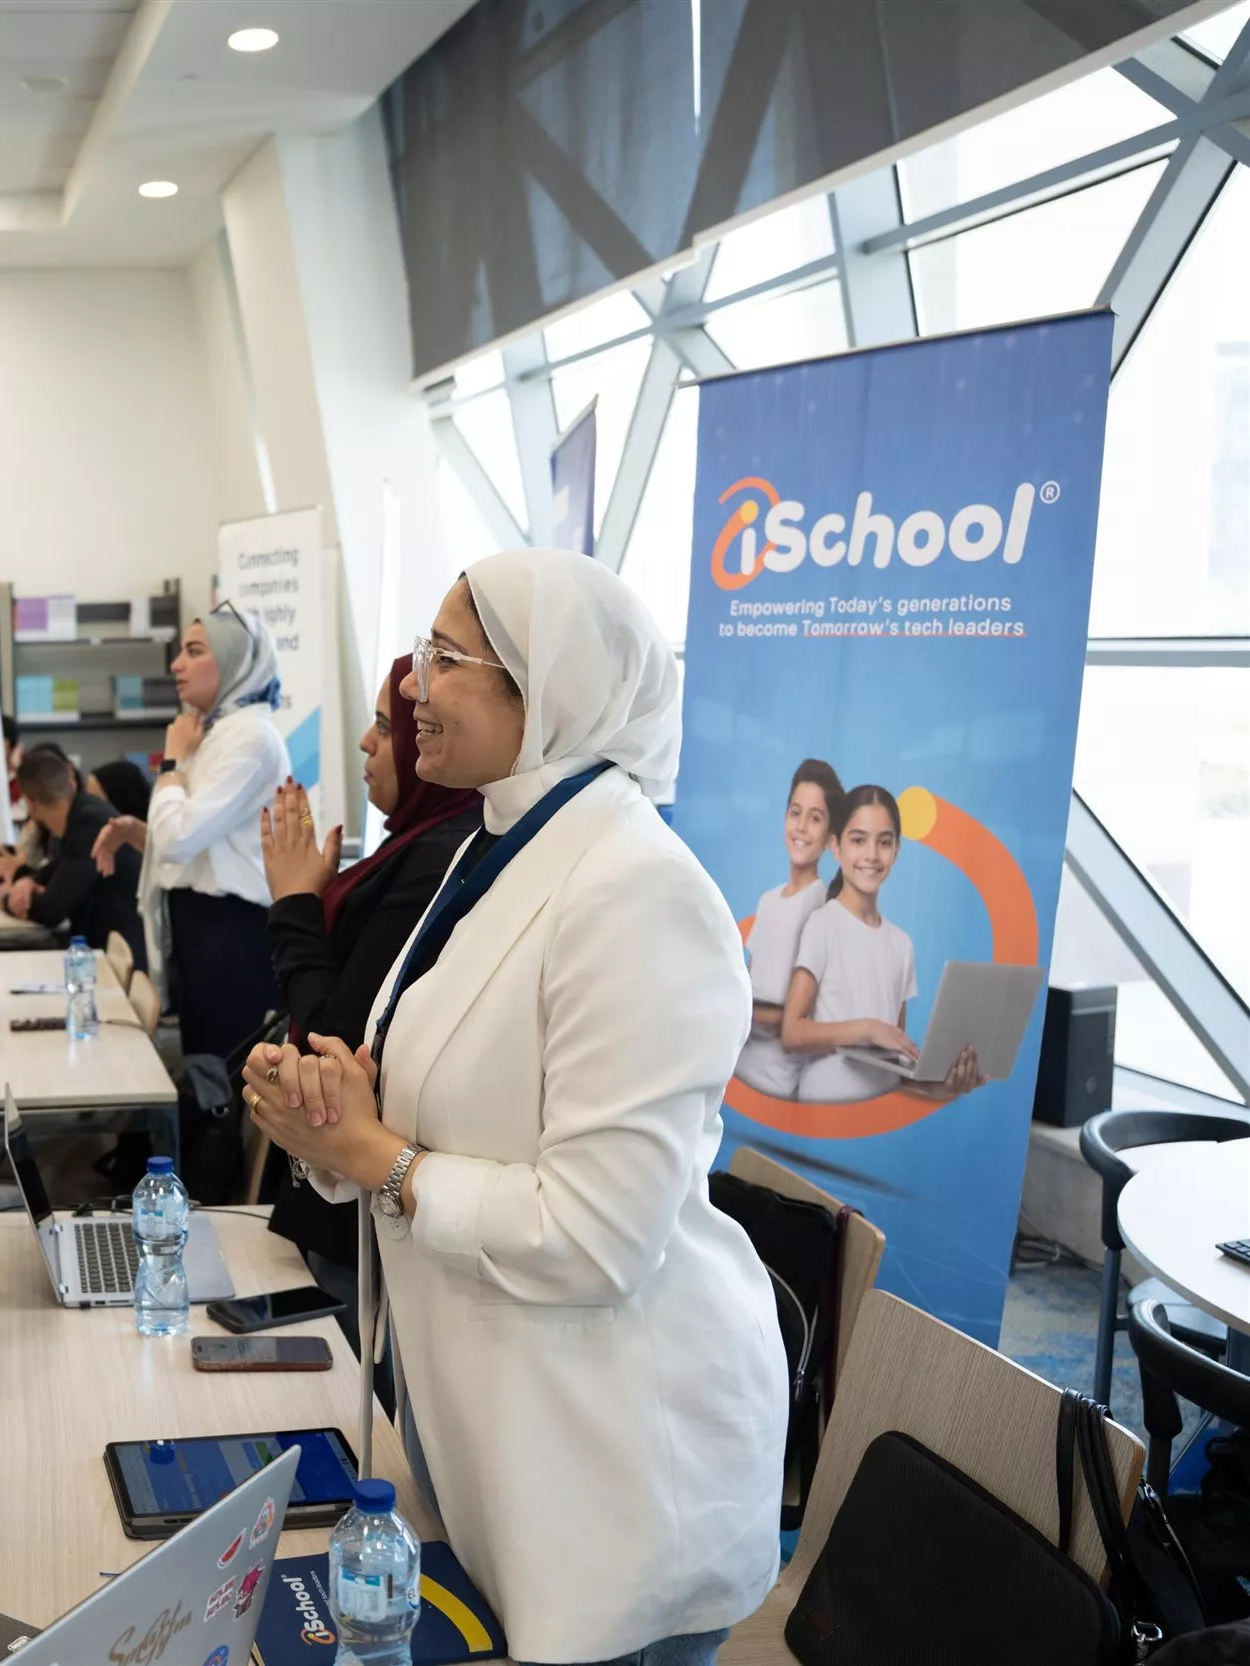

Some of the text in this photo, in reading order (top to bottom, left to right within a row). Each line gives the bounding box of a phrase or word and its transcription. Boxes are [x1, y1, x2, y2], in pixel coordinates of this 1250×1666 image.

[730, 594, 1012, 618] Empowering Today's generations
[719, 617, 1025, 637] to become Tomorrow's tech leaders
